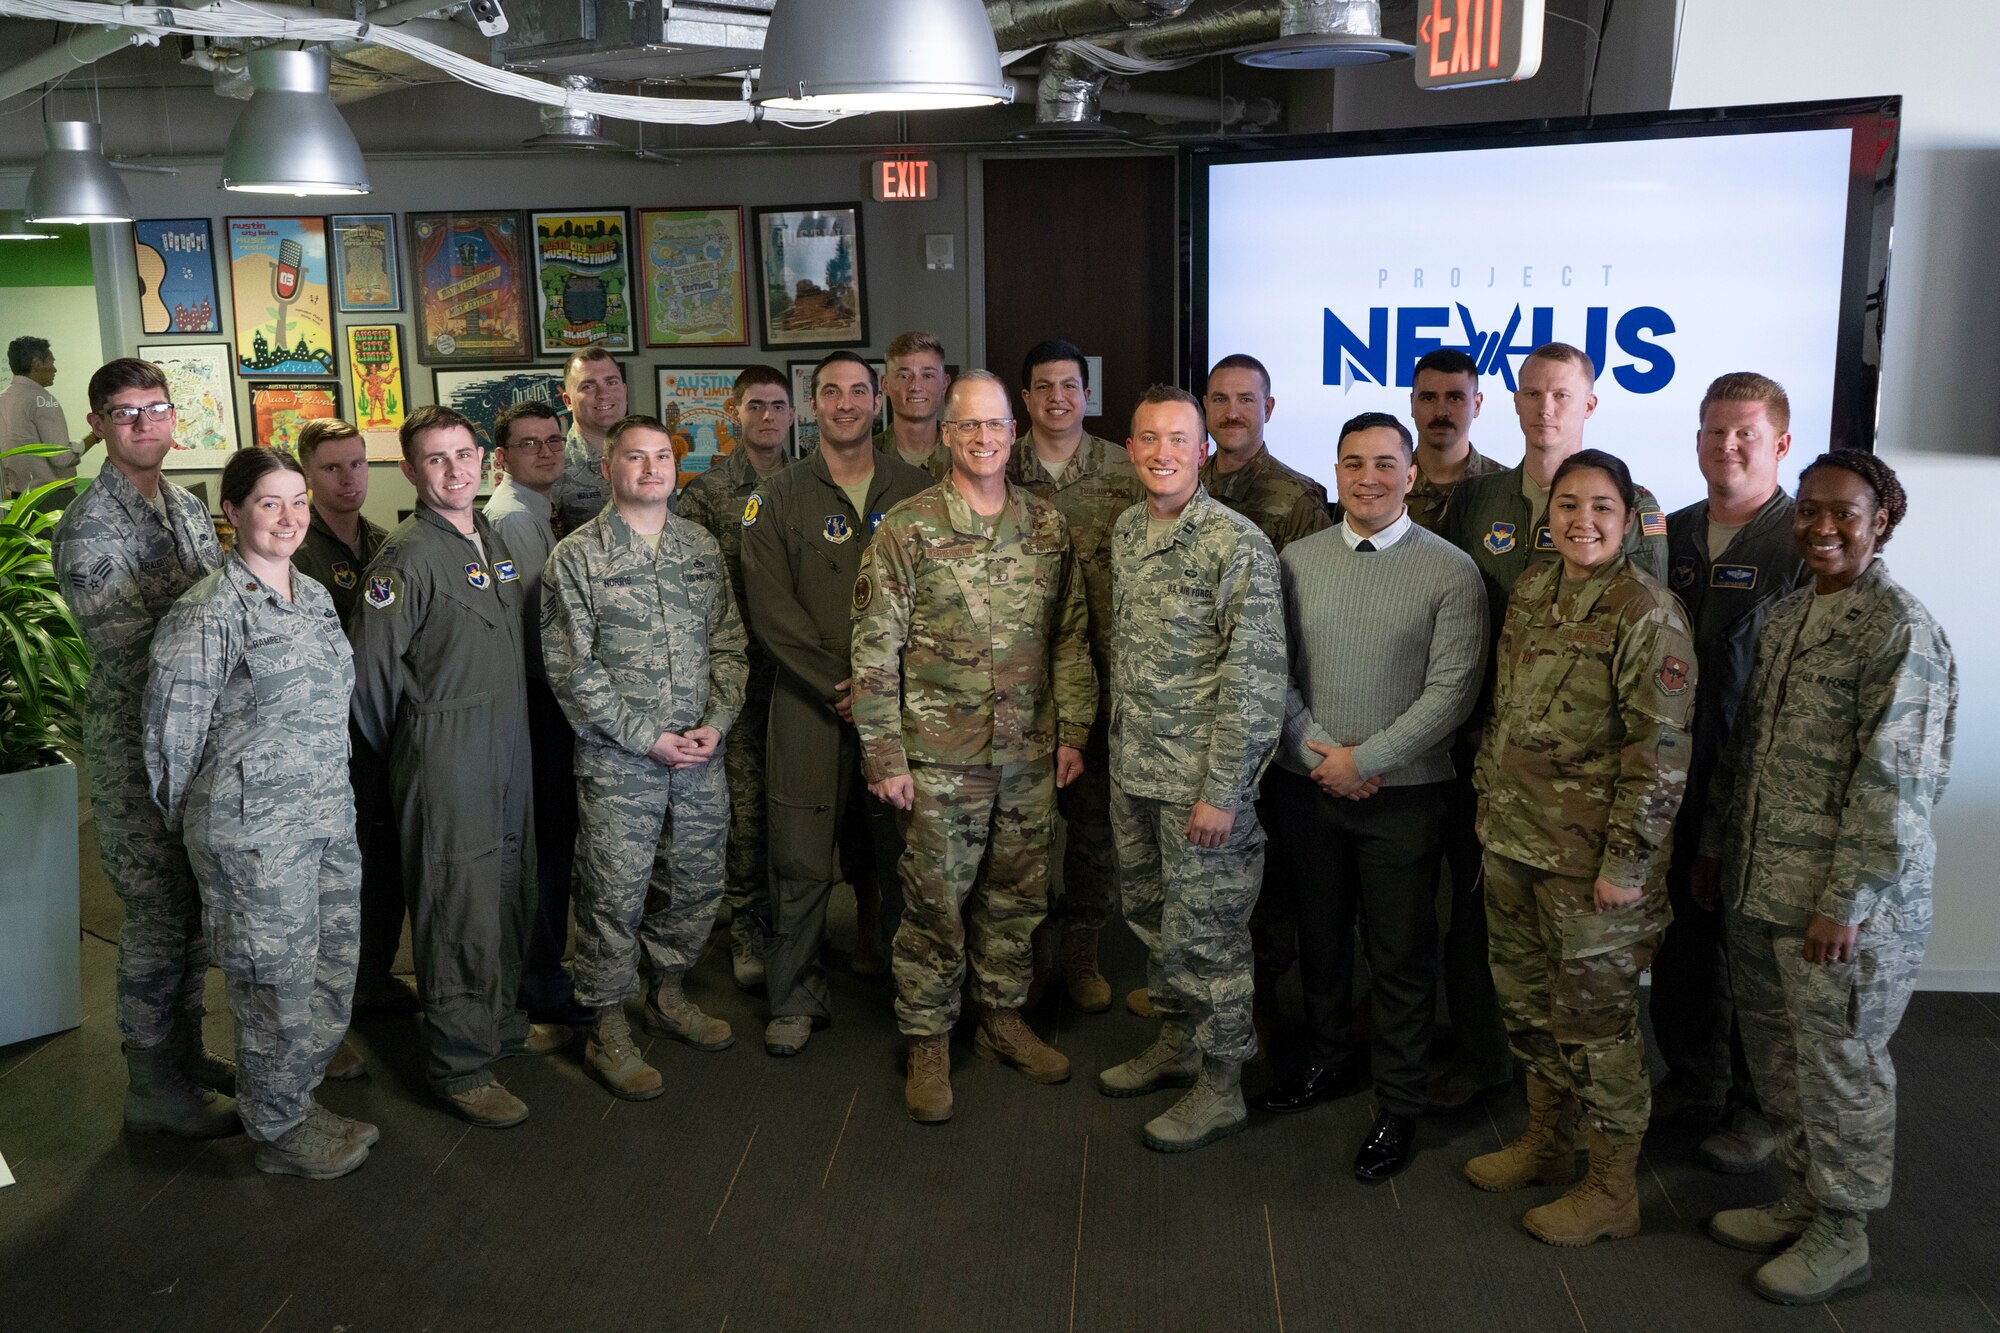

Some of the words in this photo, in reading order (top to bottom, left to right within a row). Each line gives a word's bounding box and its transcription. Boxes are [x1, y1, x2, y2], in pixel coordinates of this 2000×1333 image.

[882, 161, 929, 198] EXIT
[543, 248, 571, 260] MUSIC
[572, 250, 617, 264] FESTIVAL
[280, 271, 294, 287] 03
[1378, 264, 1613, 289] PROJECT
[355, 330, 391, 341] AUSTIN
[563, 329, 592, 339] ZILKER
[362, 341, 384, 351] CITY
[1322, 301, 1676, 394] NEXUS
[356, 351, 392, 362] LIMITS
[676, 375, 736, 388] AUSTIN
[251, 389, 292, 405] Music
[291, 390, 336, 406] Festival
[676, 387, 699, 397] CITY
[36, 396, 59, 408] Dale
[1180, 586, 1190, 597] AIR
[1191, 588, 1213, 599] FORCE
